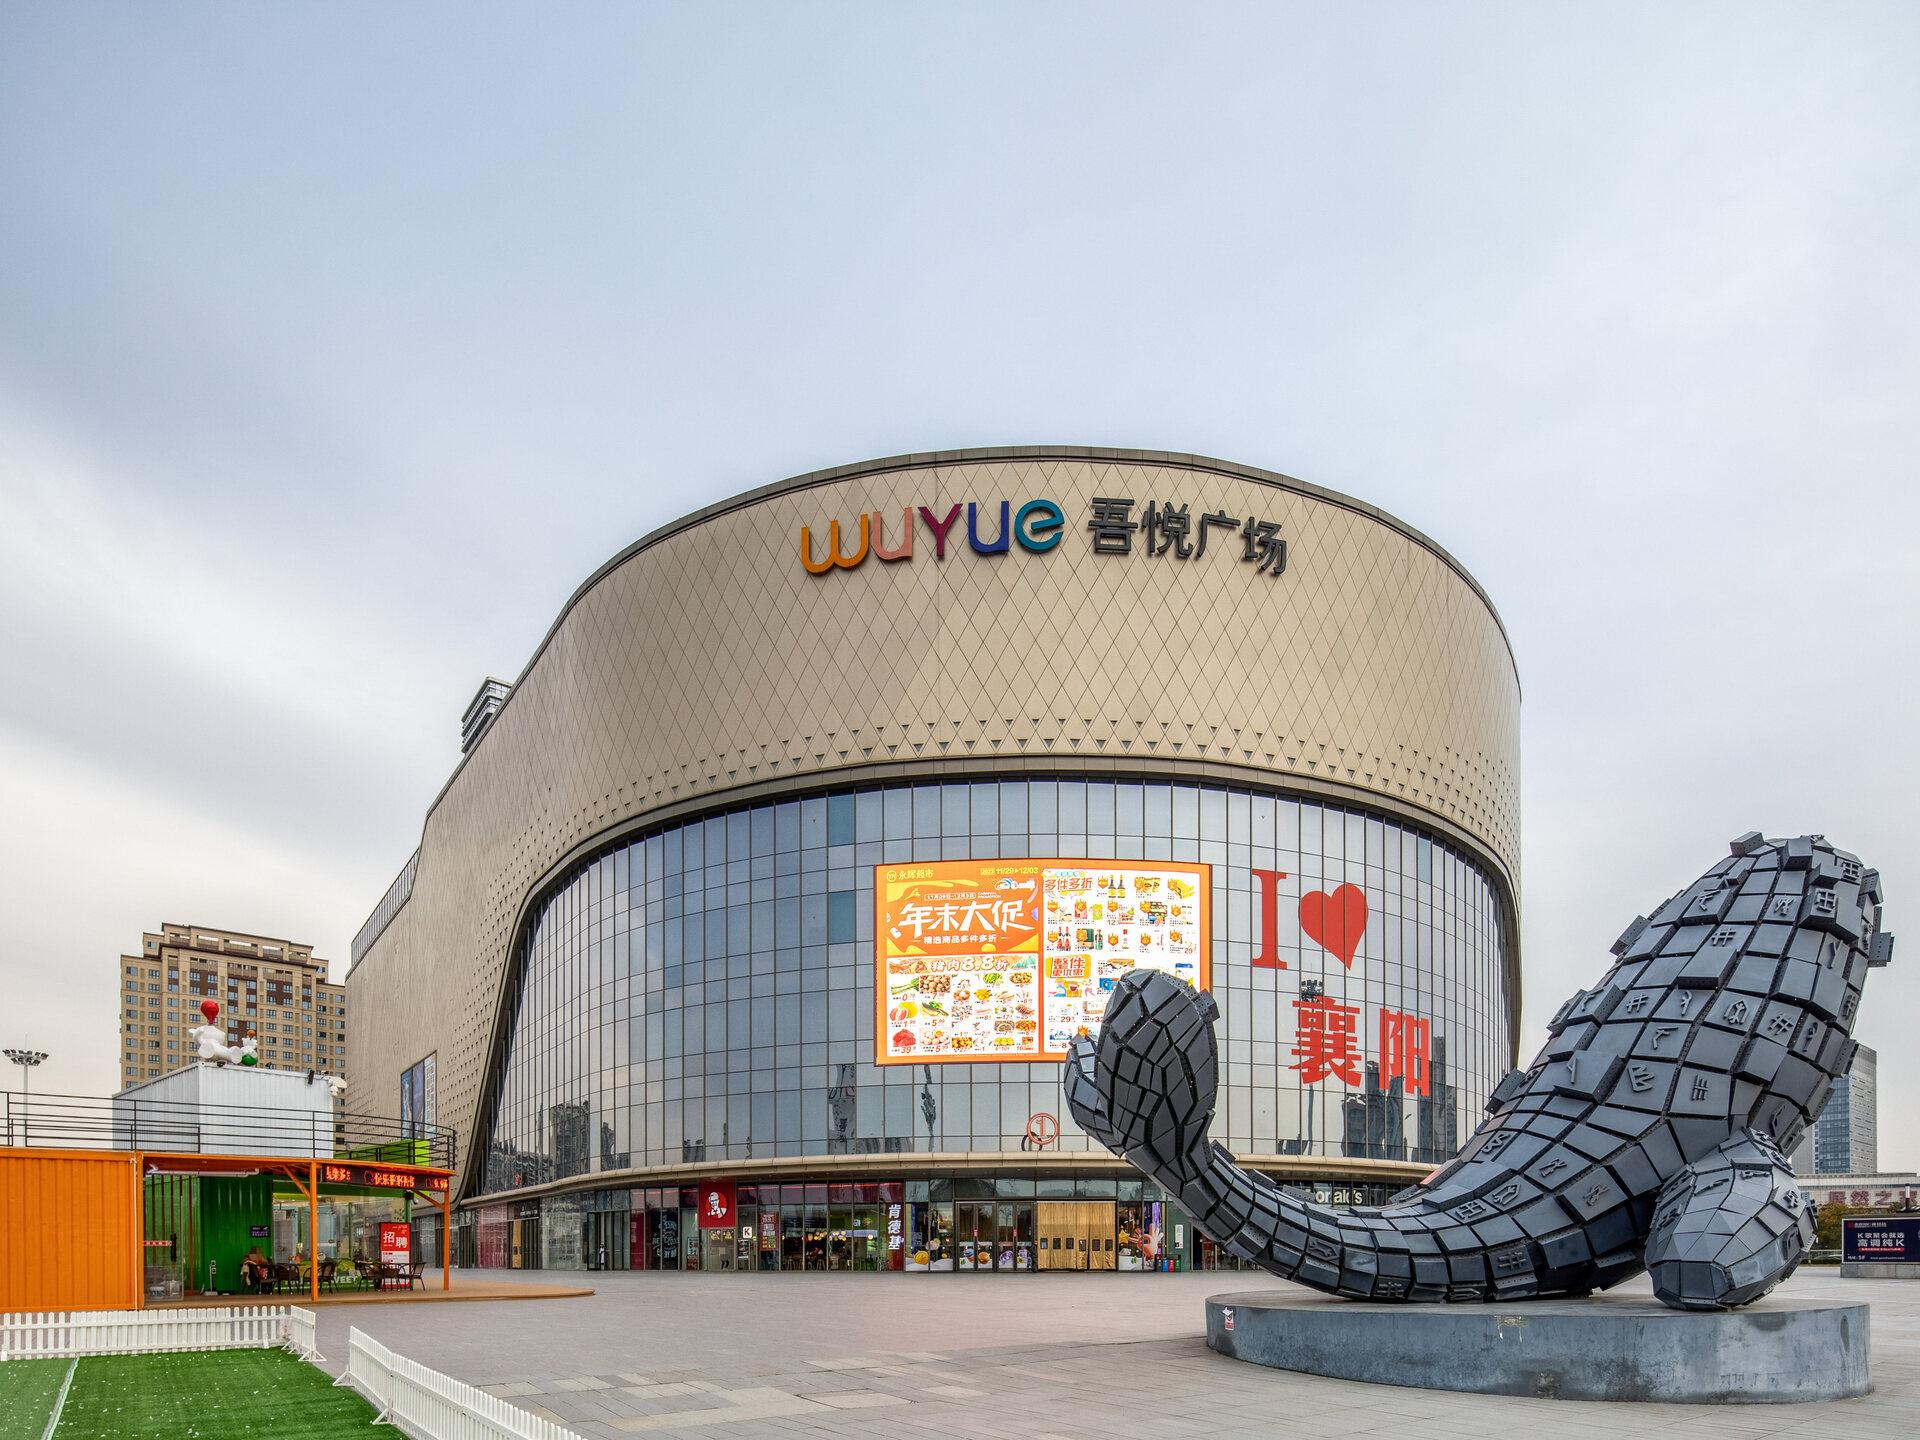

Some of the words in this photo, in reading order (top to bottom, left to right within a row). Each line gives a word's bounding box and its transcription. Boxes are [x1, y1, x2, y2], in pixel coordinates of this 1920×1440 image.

[1087, 497, 1289, 576] 吾悦广场
[898, 869, 933, 880] 永辉超市
[1044, 877, 1092, 890] 多件多折
[898, 900, 1035, 939] 年末大促
[923, 934, 997, 945] 精选商品多件多折
[930, 956, 1009, 973] 猪肉8.8折
[1287, 994, 1431, 1098] 襄阳
[887, 1203, 902, 1250] 肯德基
[383, 1231, 408, 1248] 招聘
